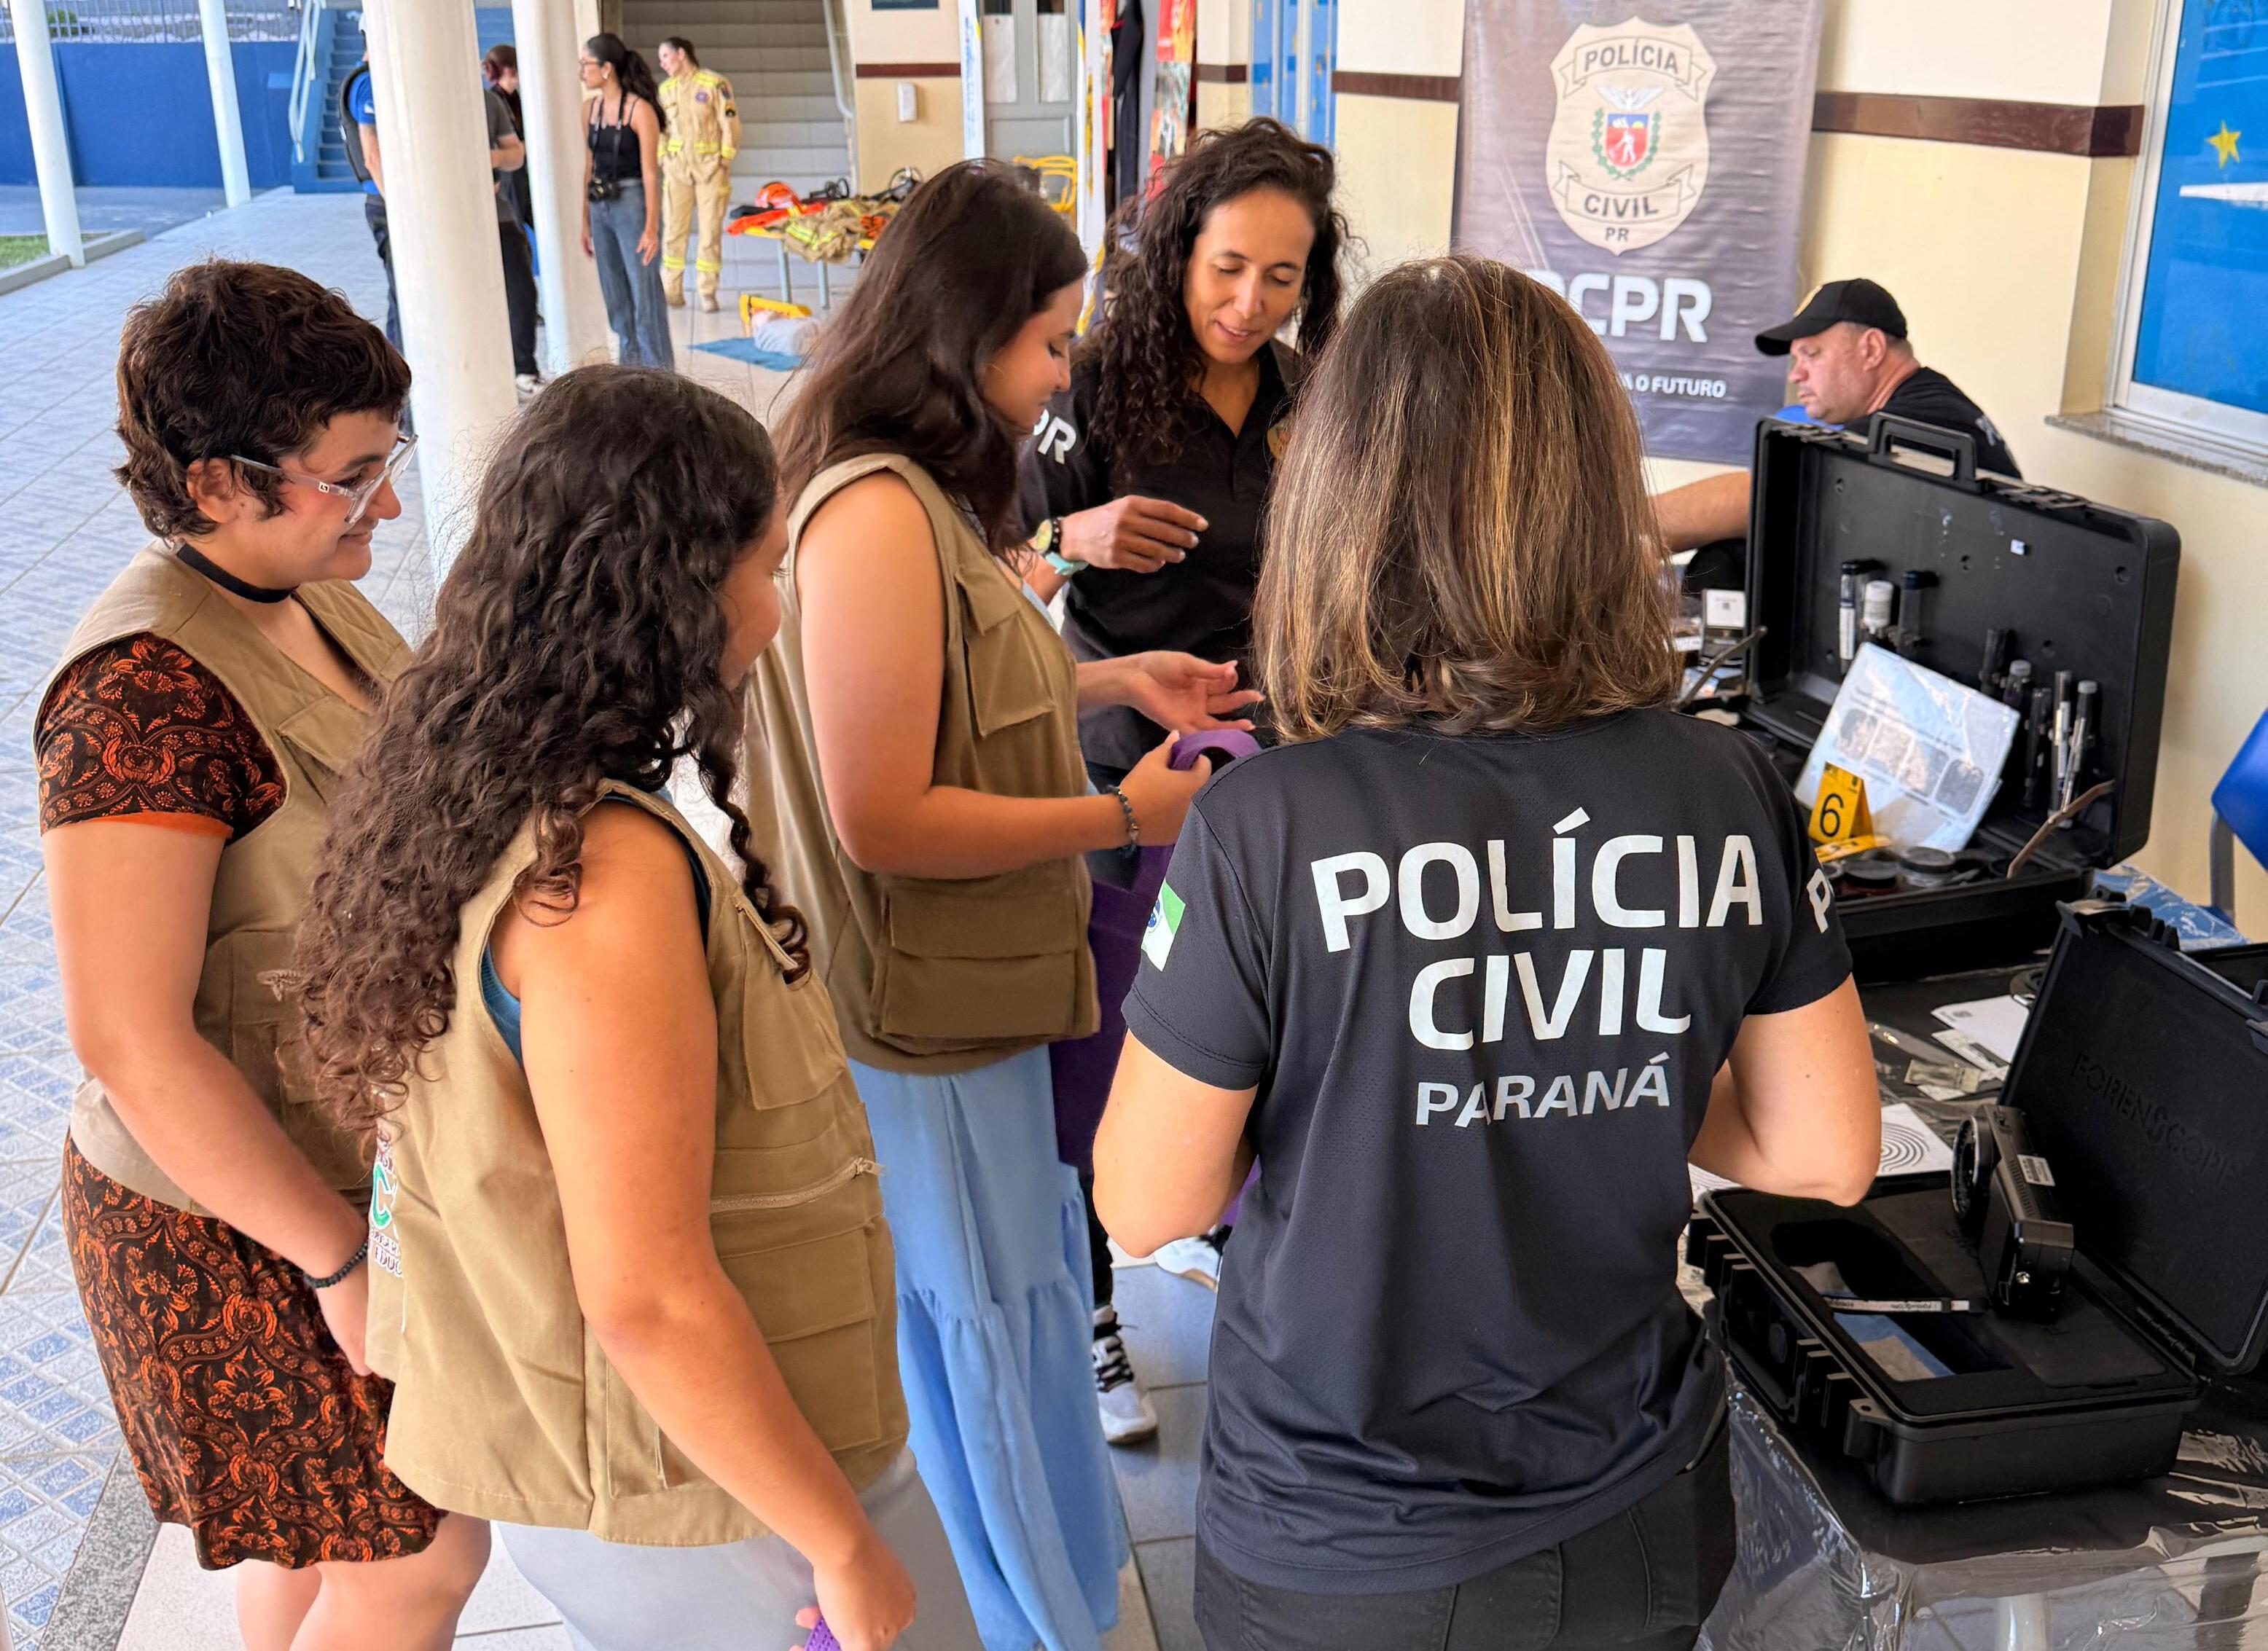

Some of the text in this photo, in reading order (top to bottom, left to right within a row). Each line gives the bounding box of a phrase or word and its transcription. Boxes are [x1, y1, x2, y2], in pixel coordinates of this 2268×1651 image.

[1584, 38, 1679, 74] POLÍCIA
[1584, 193, 1659, 218] CIVIL
[1605, 227, 1630, 242] PR
[1651, 375, 1727, 398] FUTURO
[1820, 793, 1845, 838] 6
[1310, 807, 1763, 953] POLÍCIA
[1409, 948, 1692, 1051] CIVIL
[1415, 1051, 1670, 1127] PARANÁ
[2070, 1051, 2237, 1189] FORENSCOPE
